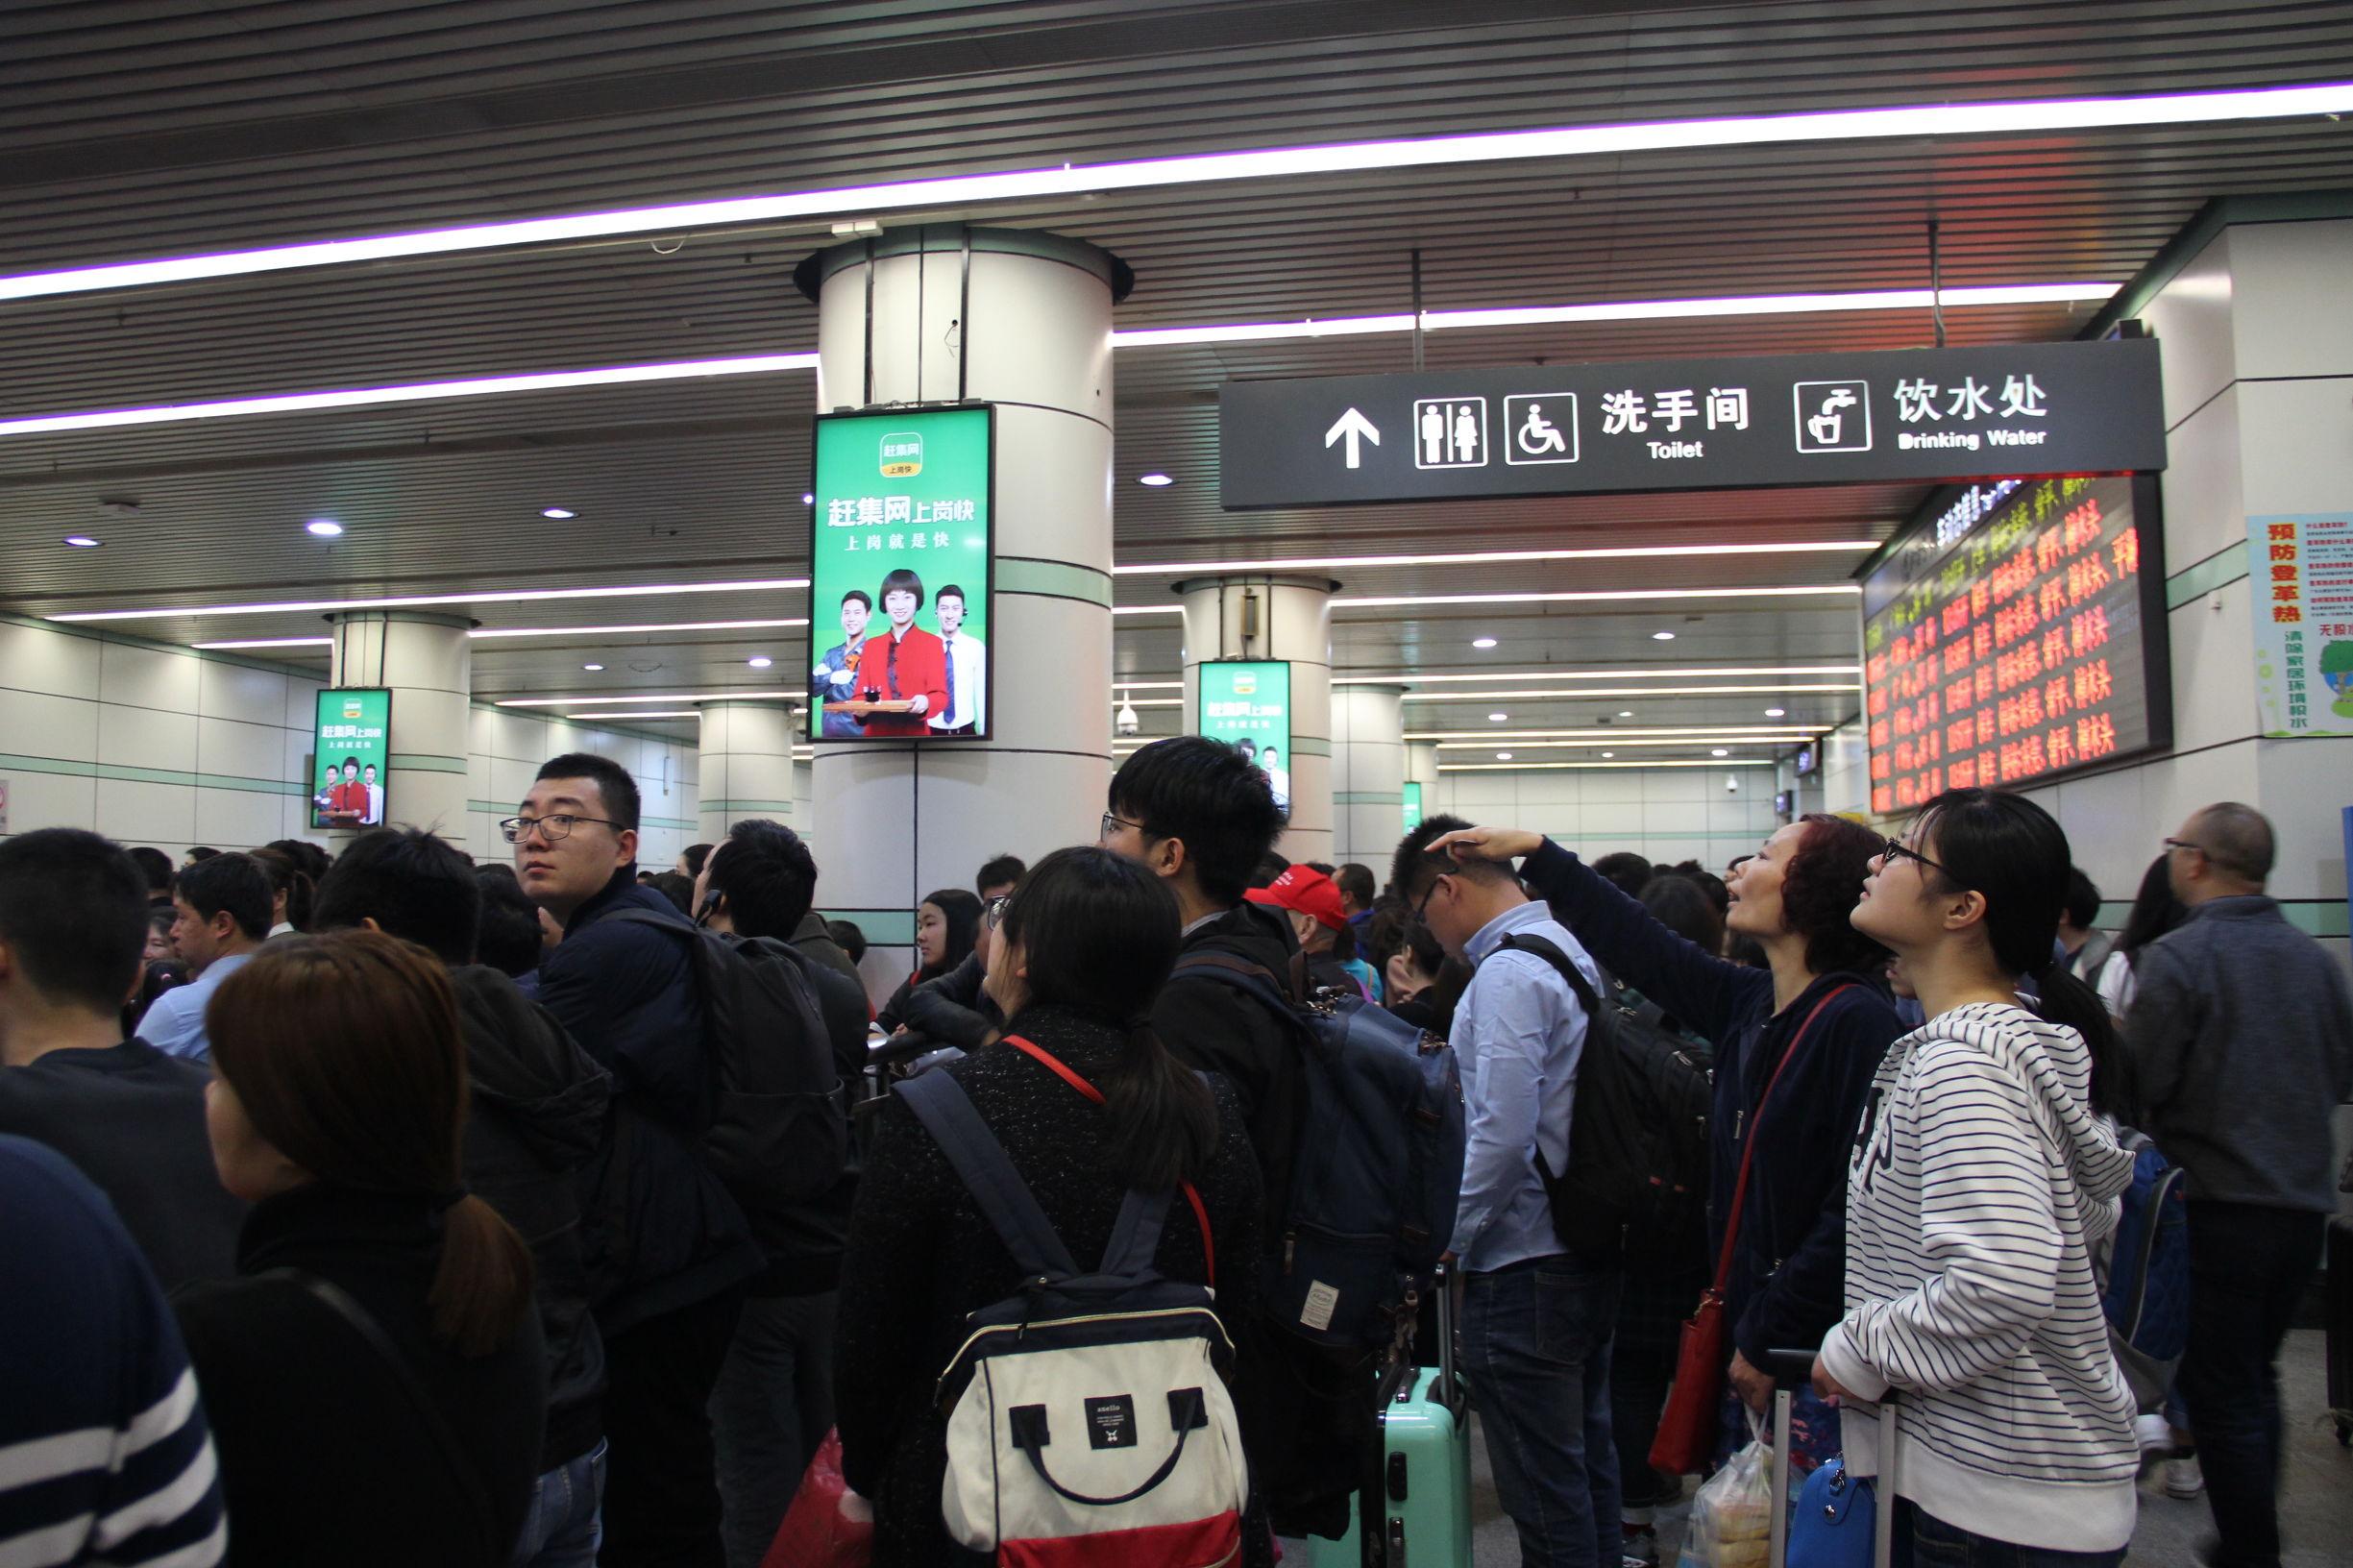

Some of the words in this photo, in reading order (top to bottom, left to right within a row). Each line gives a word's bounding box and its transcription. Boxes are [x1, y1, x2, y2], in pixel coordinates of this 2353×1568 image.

[1893, 373, 2047, 424] 饮水处
[1600, 386, 1750, 435] 洗手间
[883, 443, 919, 457] 赶集网
[1646, 440, 1704, 459] Toilet
[1898, 431, 1980, 452] Drinking
[1986, 429, 2047, 447] Water
[827, 495, 975, 527] 赶集网上岗快
[845, 530, 950, 552] 上岗就是快
[2267, 523, 2300, 624] 预防登革热
[1096, 1404, 1120, 1412] anello
